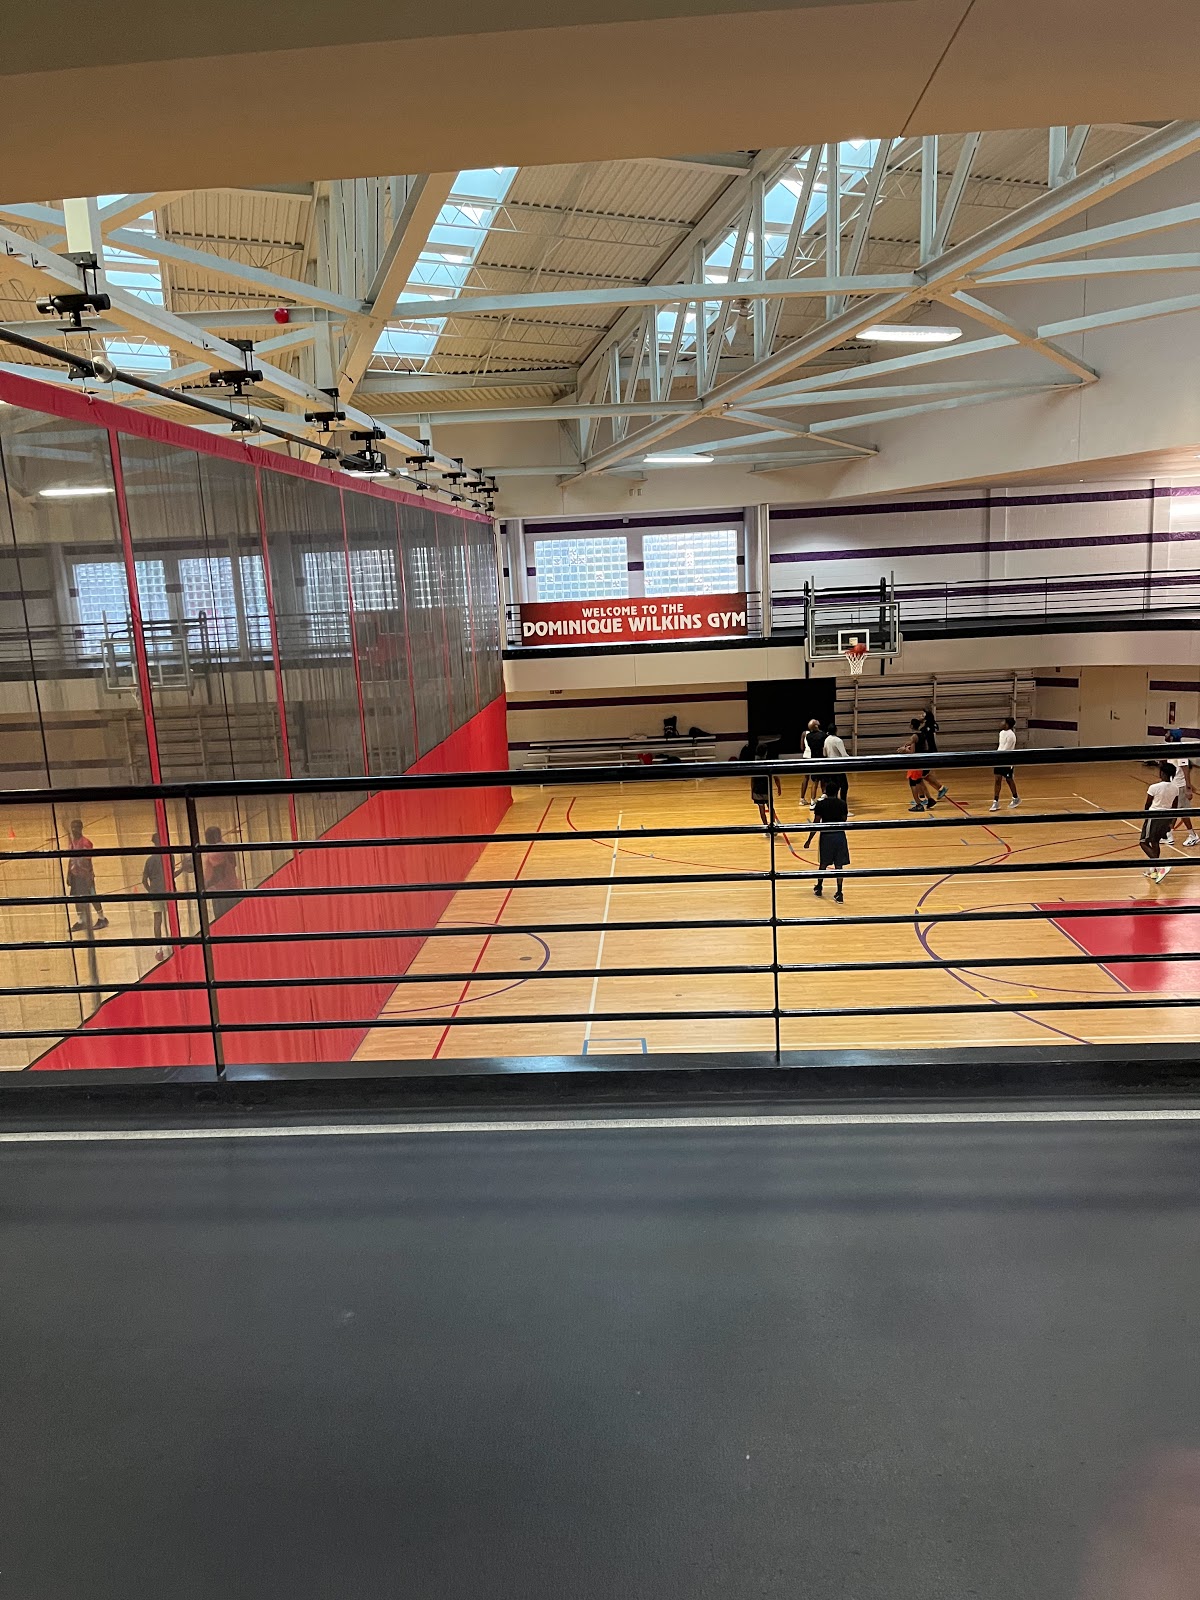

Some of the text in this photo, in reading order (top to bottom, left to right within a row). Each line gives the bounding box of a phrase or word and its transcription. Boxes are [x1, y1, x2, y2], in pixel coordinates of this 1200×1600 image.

[582, 603, 684, 617] WELCOME TO THE
[523, 612, 745, 637] DOMINIQUE WILKINS GYM
